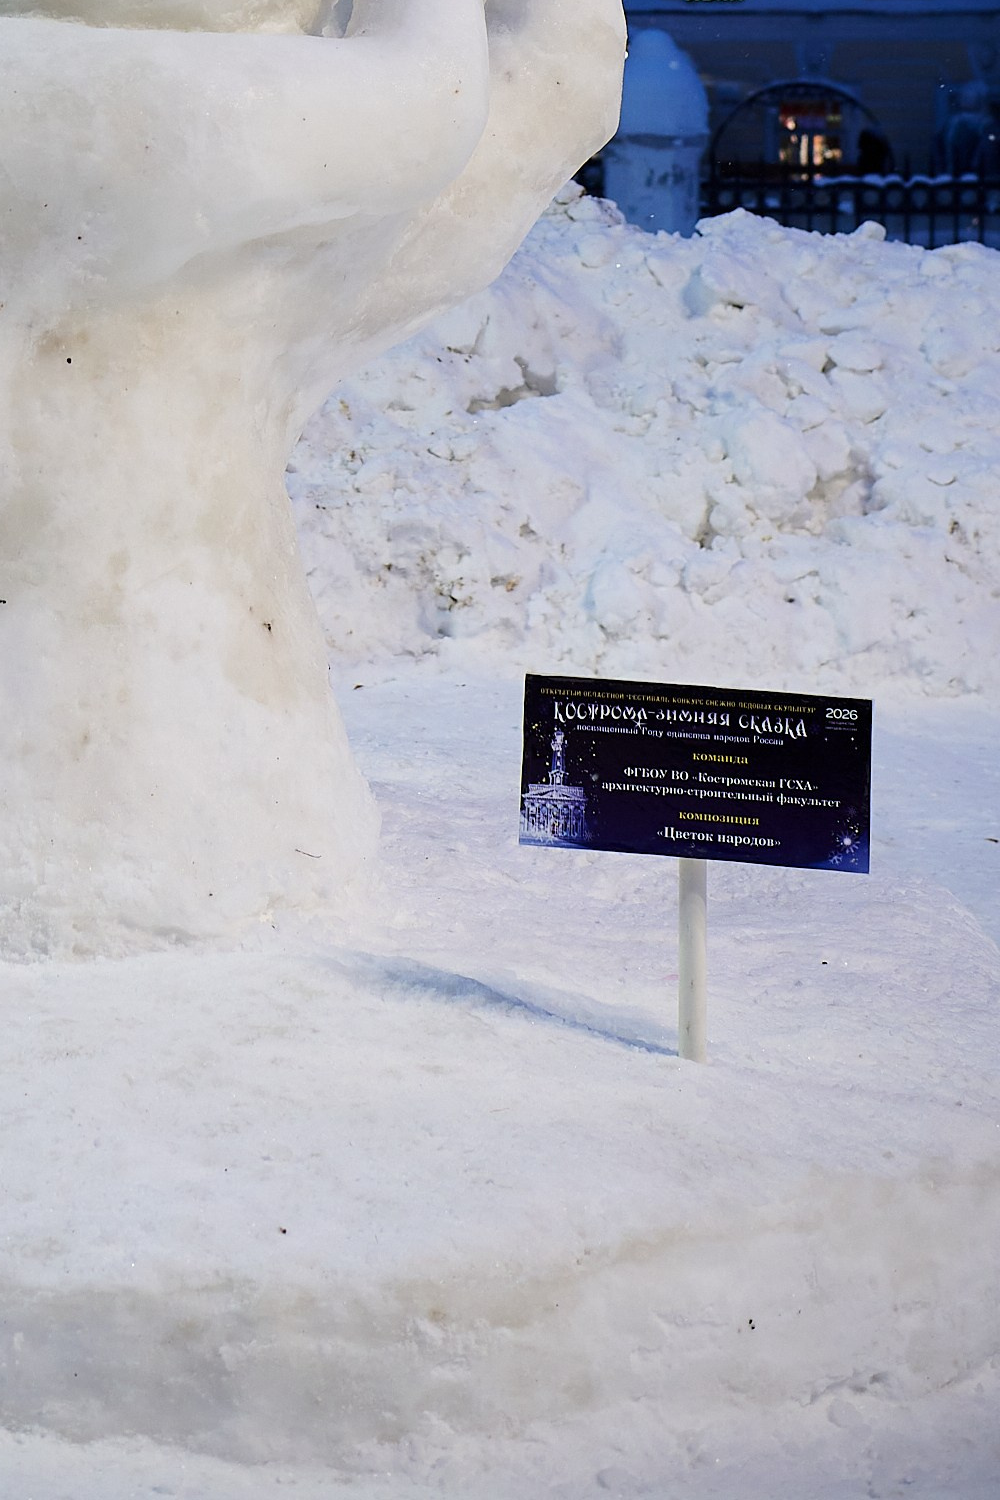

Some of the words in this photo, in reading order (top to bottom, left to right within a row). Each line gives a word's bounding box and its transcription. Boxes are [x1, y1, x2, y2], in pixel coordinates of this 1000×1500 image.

[826, 707, 859, 721] 2026
[692, 752, 749, 765] команда
[623, 766, 668, 779] ФГБОУ
[671, 769, 689, 781] ВО
[692, 772, 776, 789] «Костромская
[779, 779, 819, 791] ГСХА»
[601, 781, 774, 803] архитектурно-строительный
[776, 793, 841, 808] факультет
[678, 811, 760, 826] композиция
[656, 826, 714, 842] «Цветок
[717, 835, 781, 848] народов»
